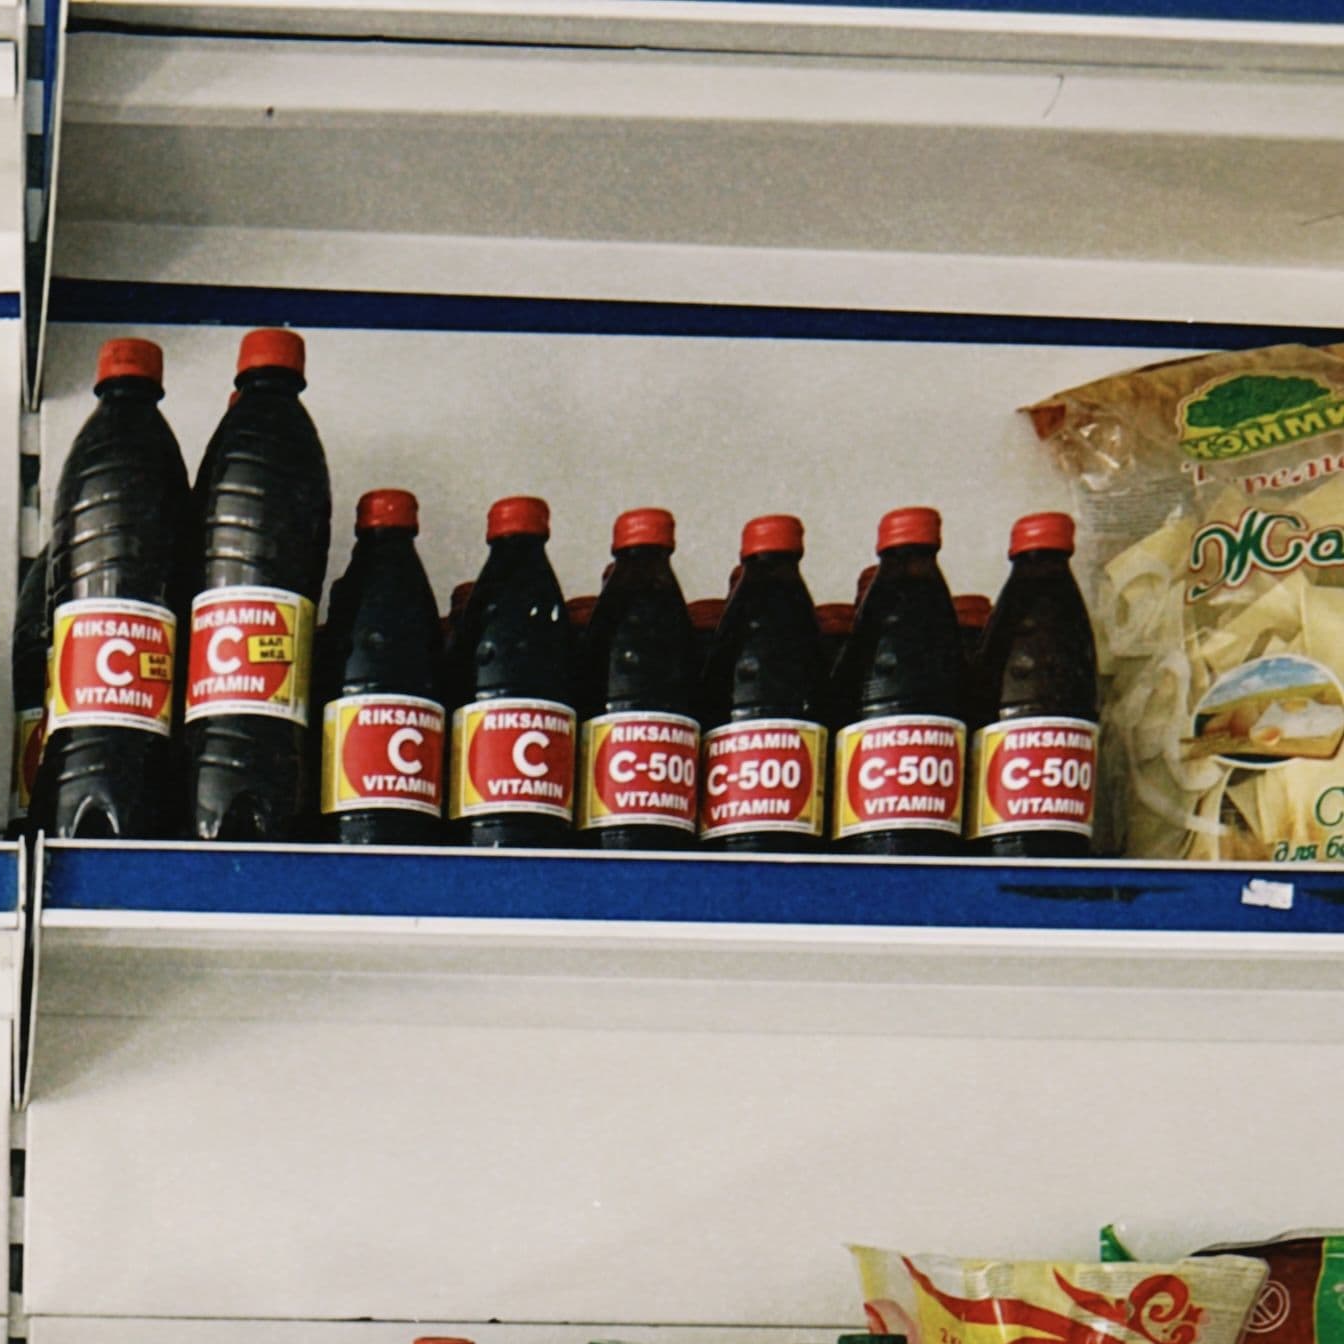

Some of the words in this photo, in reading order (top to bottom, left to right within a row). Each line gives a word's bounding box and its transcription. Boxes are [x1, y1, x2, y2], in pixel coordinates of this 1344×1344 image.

[72, 619, 163, 644] RIKSAMIN
[193, 607, 277, 632] RIKSAMIN
[95, 638, 137, 687] C
[206, 625, 245, 675] C
[74, 685, 154, 710] VITAMIN
[192, 675, 266, 697] VITAMIN
[357, 708, 445, 731] RIKSAMIN
[482, 713, 571, 736] RIKSAMIN
[611, 725, 696, 746] RIKSAMIN
[709, 730, 801, 758] RIKSAMIN
[860, 727, 956, 752] RIKSAMIN
[1004, 731, 1094, 752] RIKSAMIN
[387, 727, 424, 775] C
[512, 729, 551, 779] C
[608, 750, 696, 787] C-500
[707, 758, 802, 796] C-500
[858, 756, 955, 791] C-500
[1001, 757, 1093, 791] C-500
[361, 774, 437, 797] VITAMIN
[487, 778, 564, 799] VITAMIN
[614, 791, 690, 812] VITAMIN
[711, 797, 791, 821] VITAMIN
[863, 795, 946, 816] VITAMIN
[1007, 797, 1086, 816] VITAMIN
